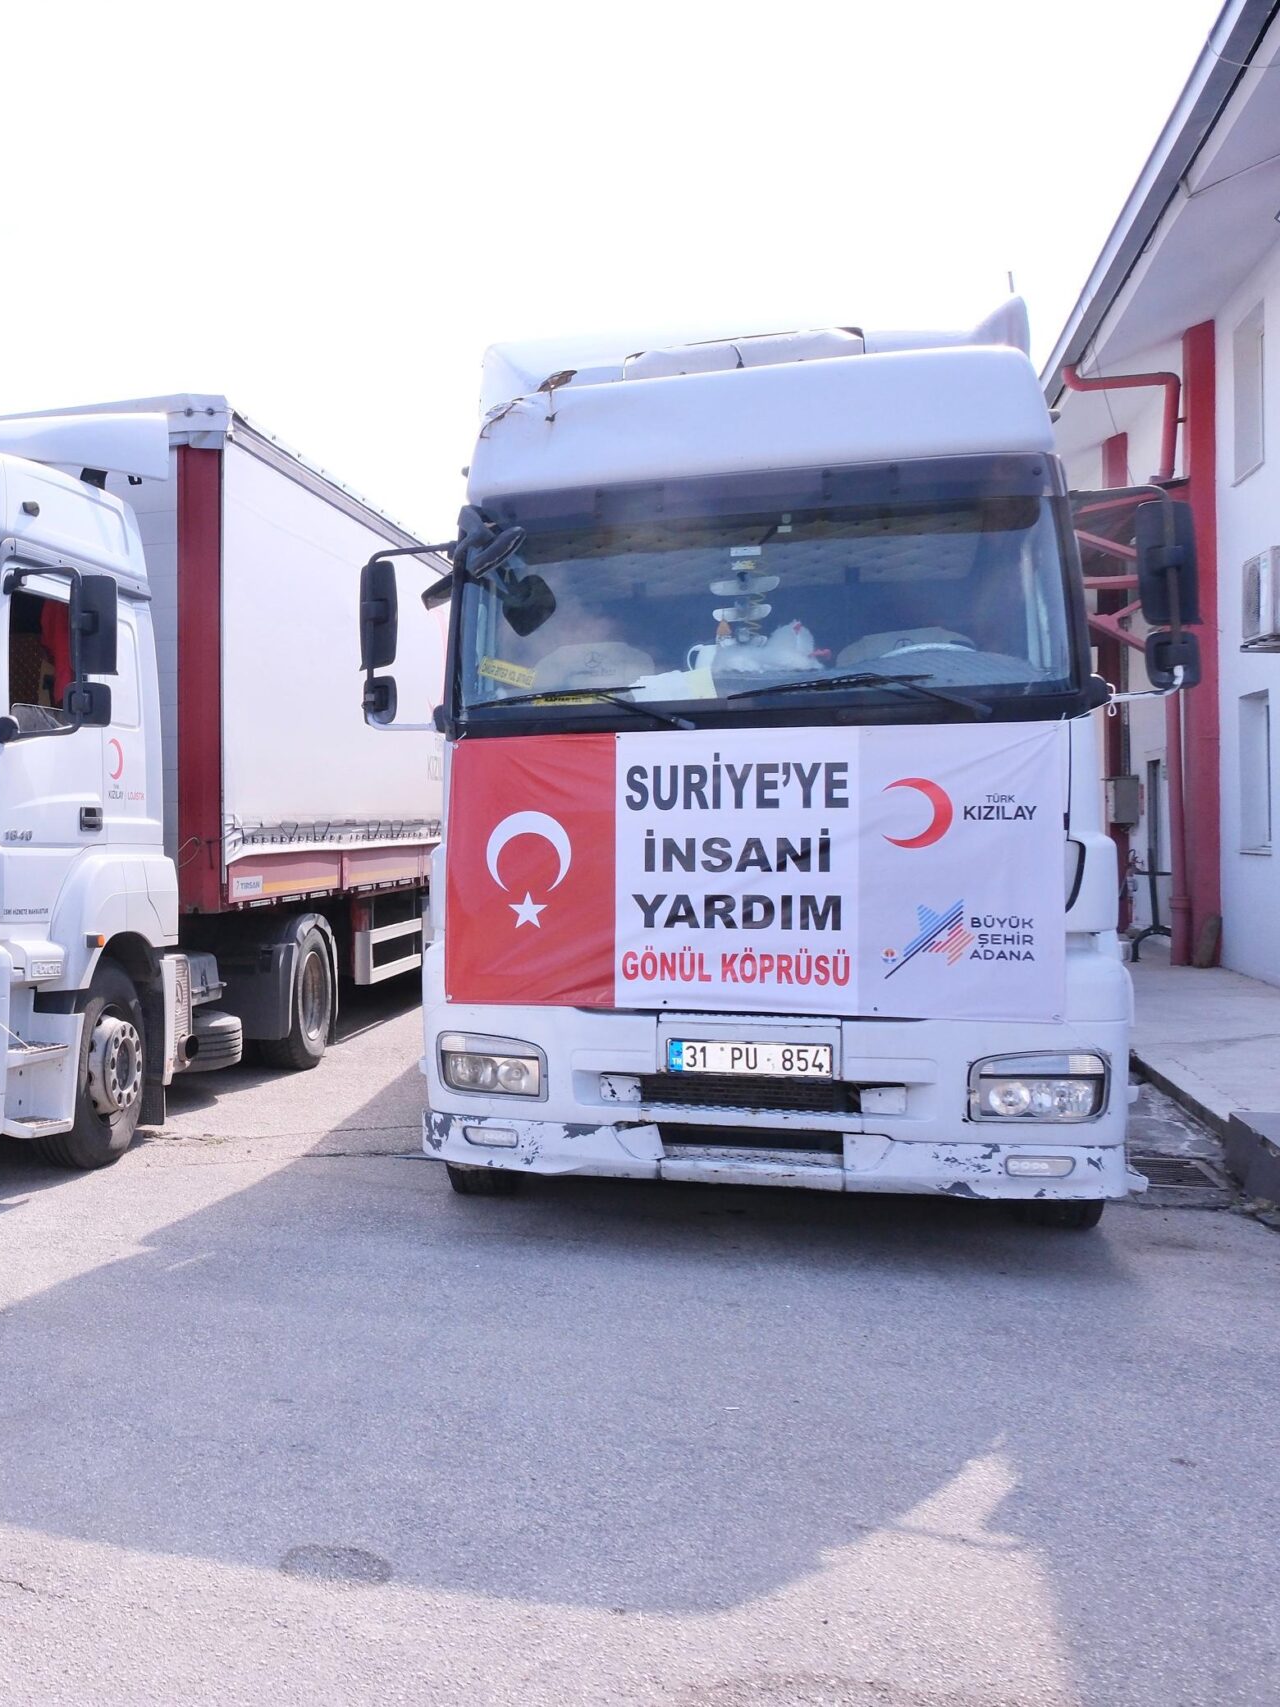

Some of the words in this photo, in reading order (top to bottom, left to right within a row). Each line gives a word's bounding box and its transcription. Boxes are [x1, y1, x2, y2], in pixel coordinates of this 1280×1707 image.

[625, 752, 849, 811] SURİYE'YE
[986, 793, 1015, 803] TÜRK
[963, 805, 1037, 820] KIZILAY
[644, 828, 831, 873] İNSANİ
[632, 894, 842, 931] YARDIM
[971, 915, 1033, 928] BÜYÜK
[978, 932, 1034, 948] ŞEHİR
[622, 945, 712, 982] GÖNÜL
[721, 947, 851, 986] KÖPRÜSÜ
[969, 949, 1035, 961] ADANA
[685, 1045, 707, 1068] 31
[731, 1047, 758, 1070] PU
[781, 1049, 824, 1072] 854
